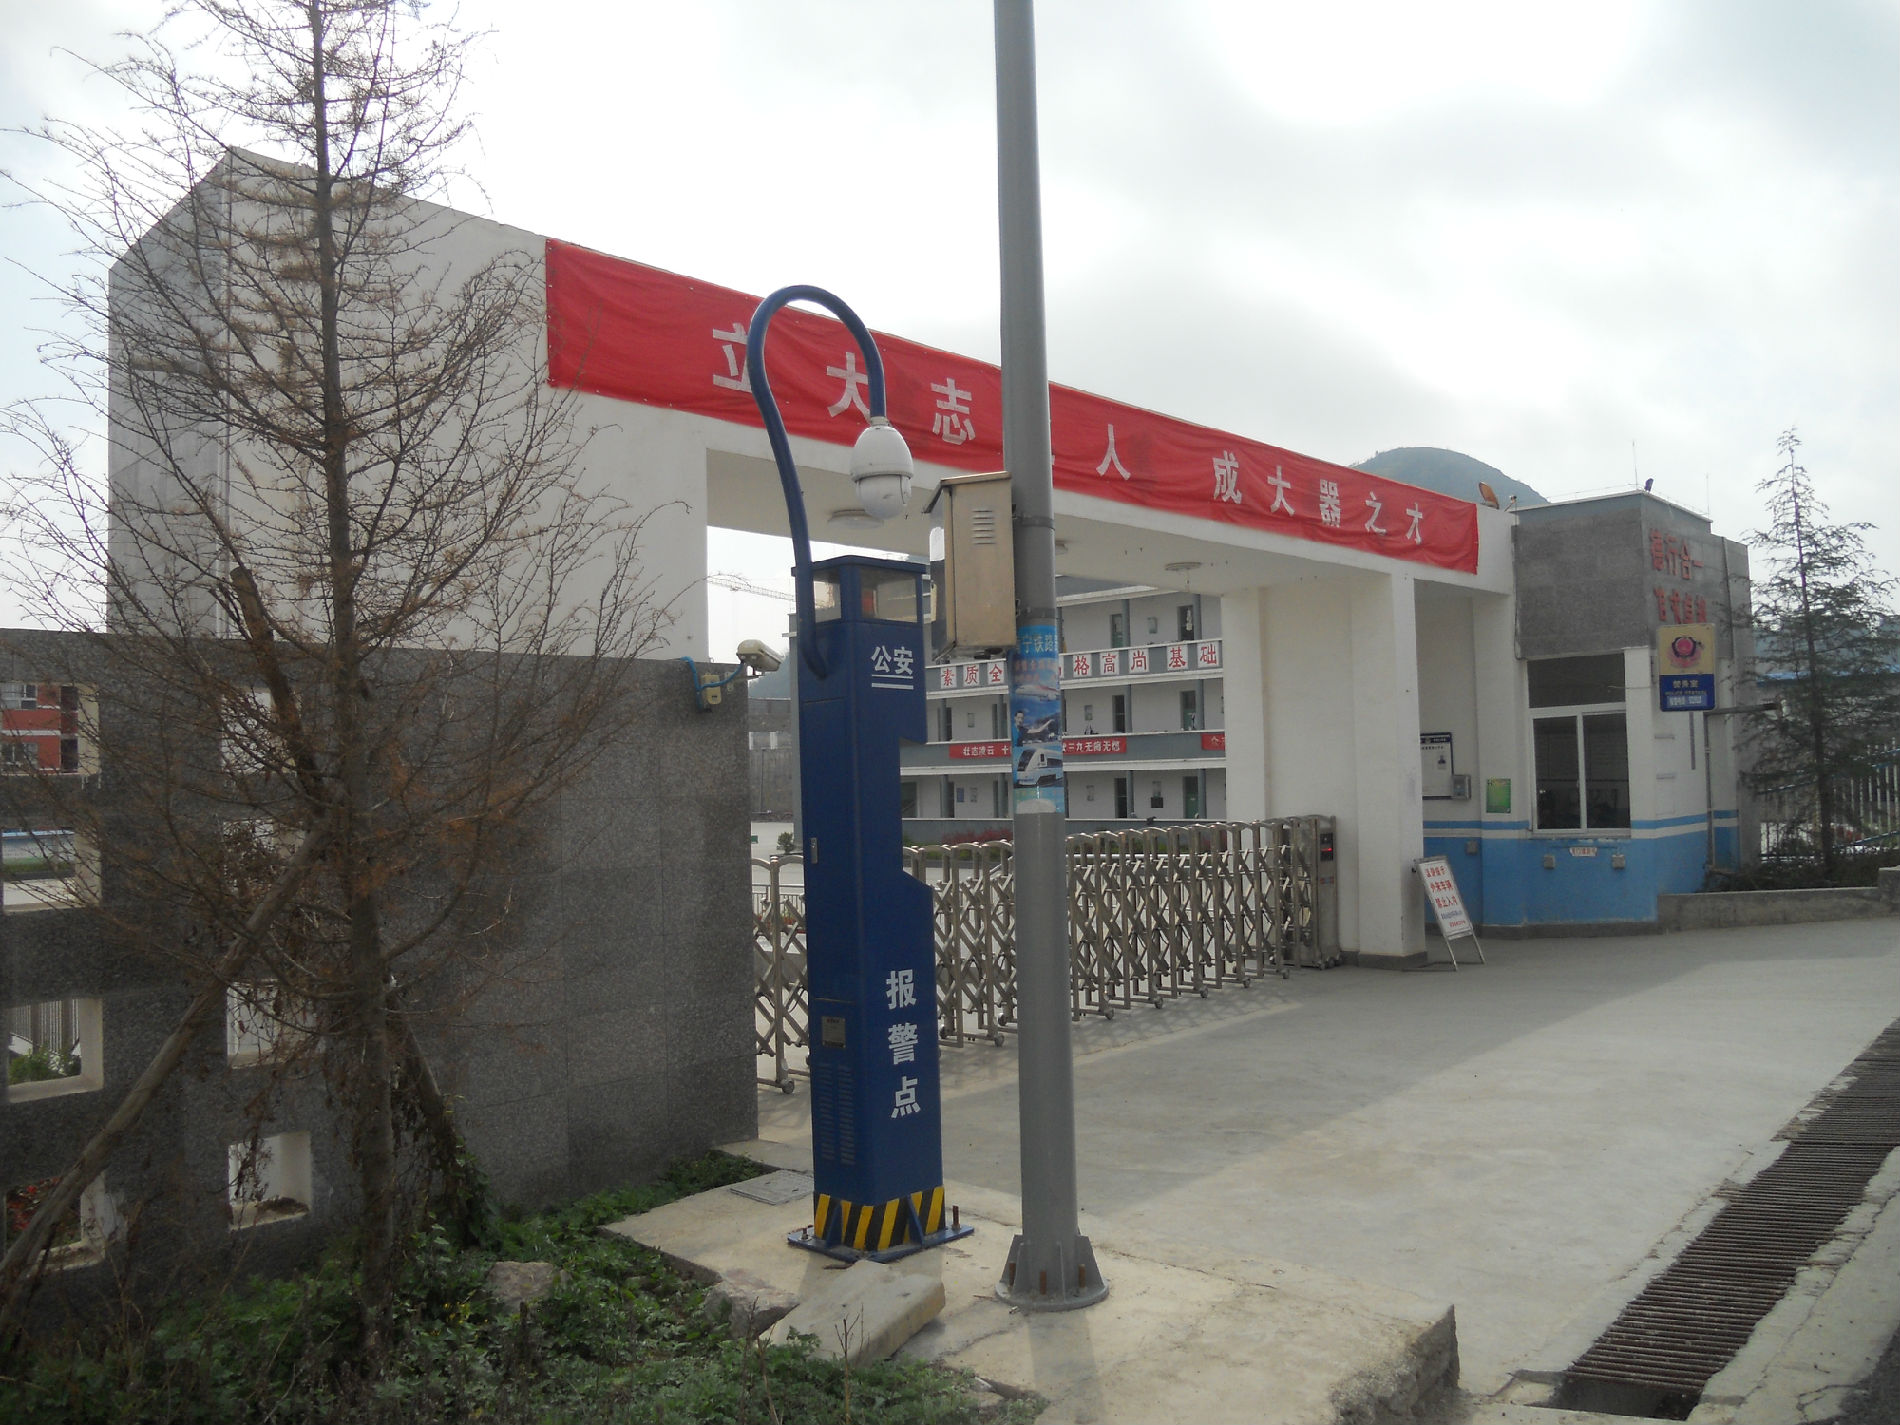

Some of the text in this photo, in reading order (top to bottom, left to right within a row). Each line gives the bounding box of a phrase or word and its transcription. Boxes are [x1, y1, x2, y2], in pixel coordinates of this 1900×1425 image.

[1213, 449, 1424, 545] 成大器之才
[871, 645, 914, 675] 公安
[1169, 643, 1217, 669] 基础
[886, 968, 921, 1119] 报警点
